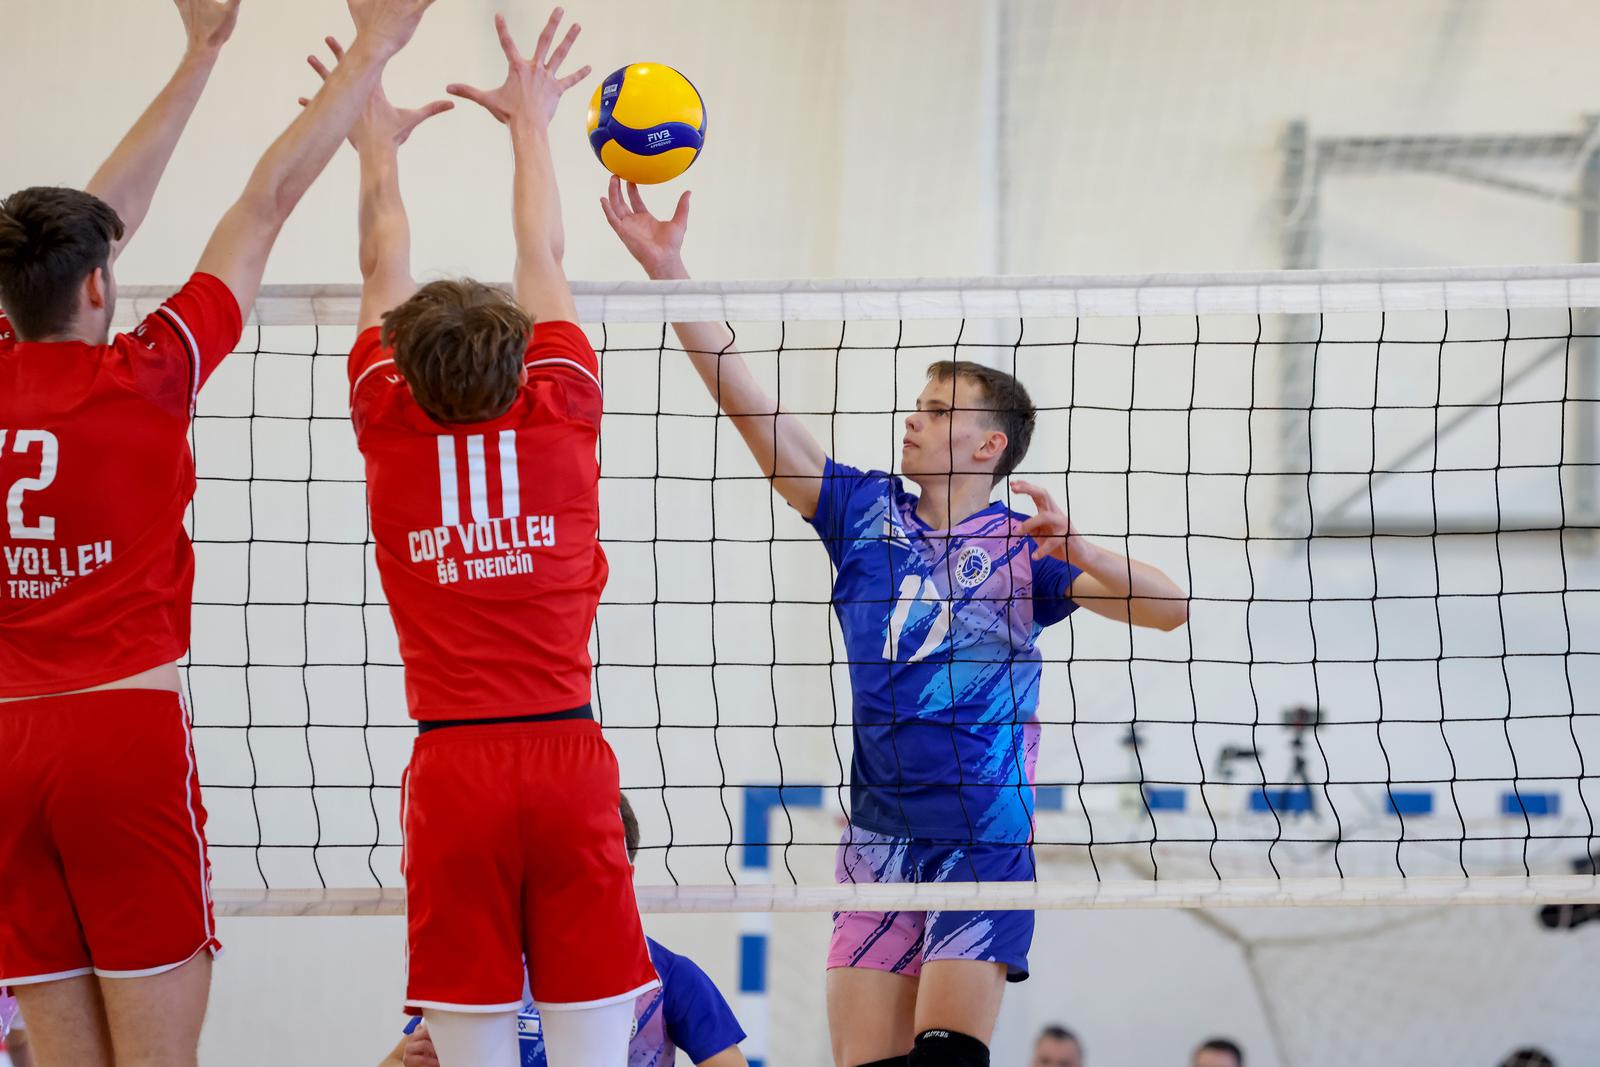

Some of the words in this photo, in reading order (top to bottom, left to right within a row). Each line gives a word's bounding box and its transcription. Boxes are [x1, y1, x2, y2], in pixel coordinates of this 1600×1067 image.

[648, 129, 671, 142] FIVB
[408, 529, 451, 563] COP
[456, 515, 556, 554] VOLLEY
